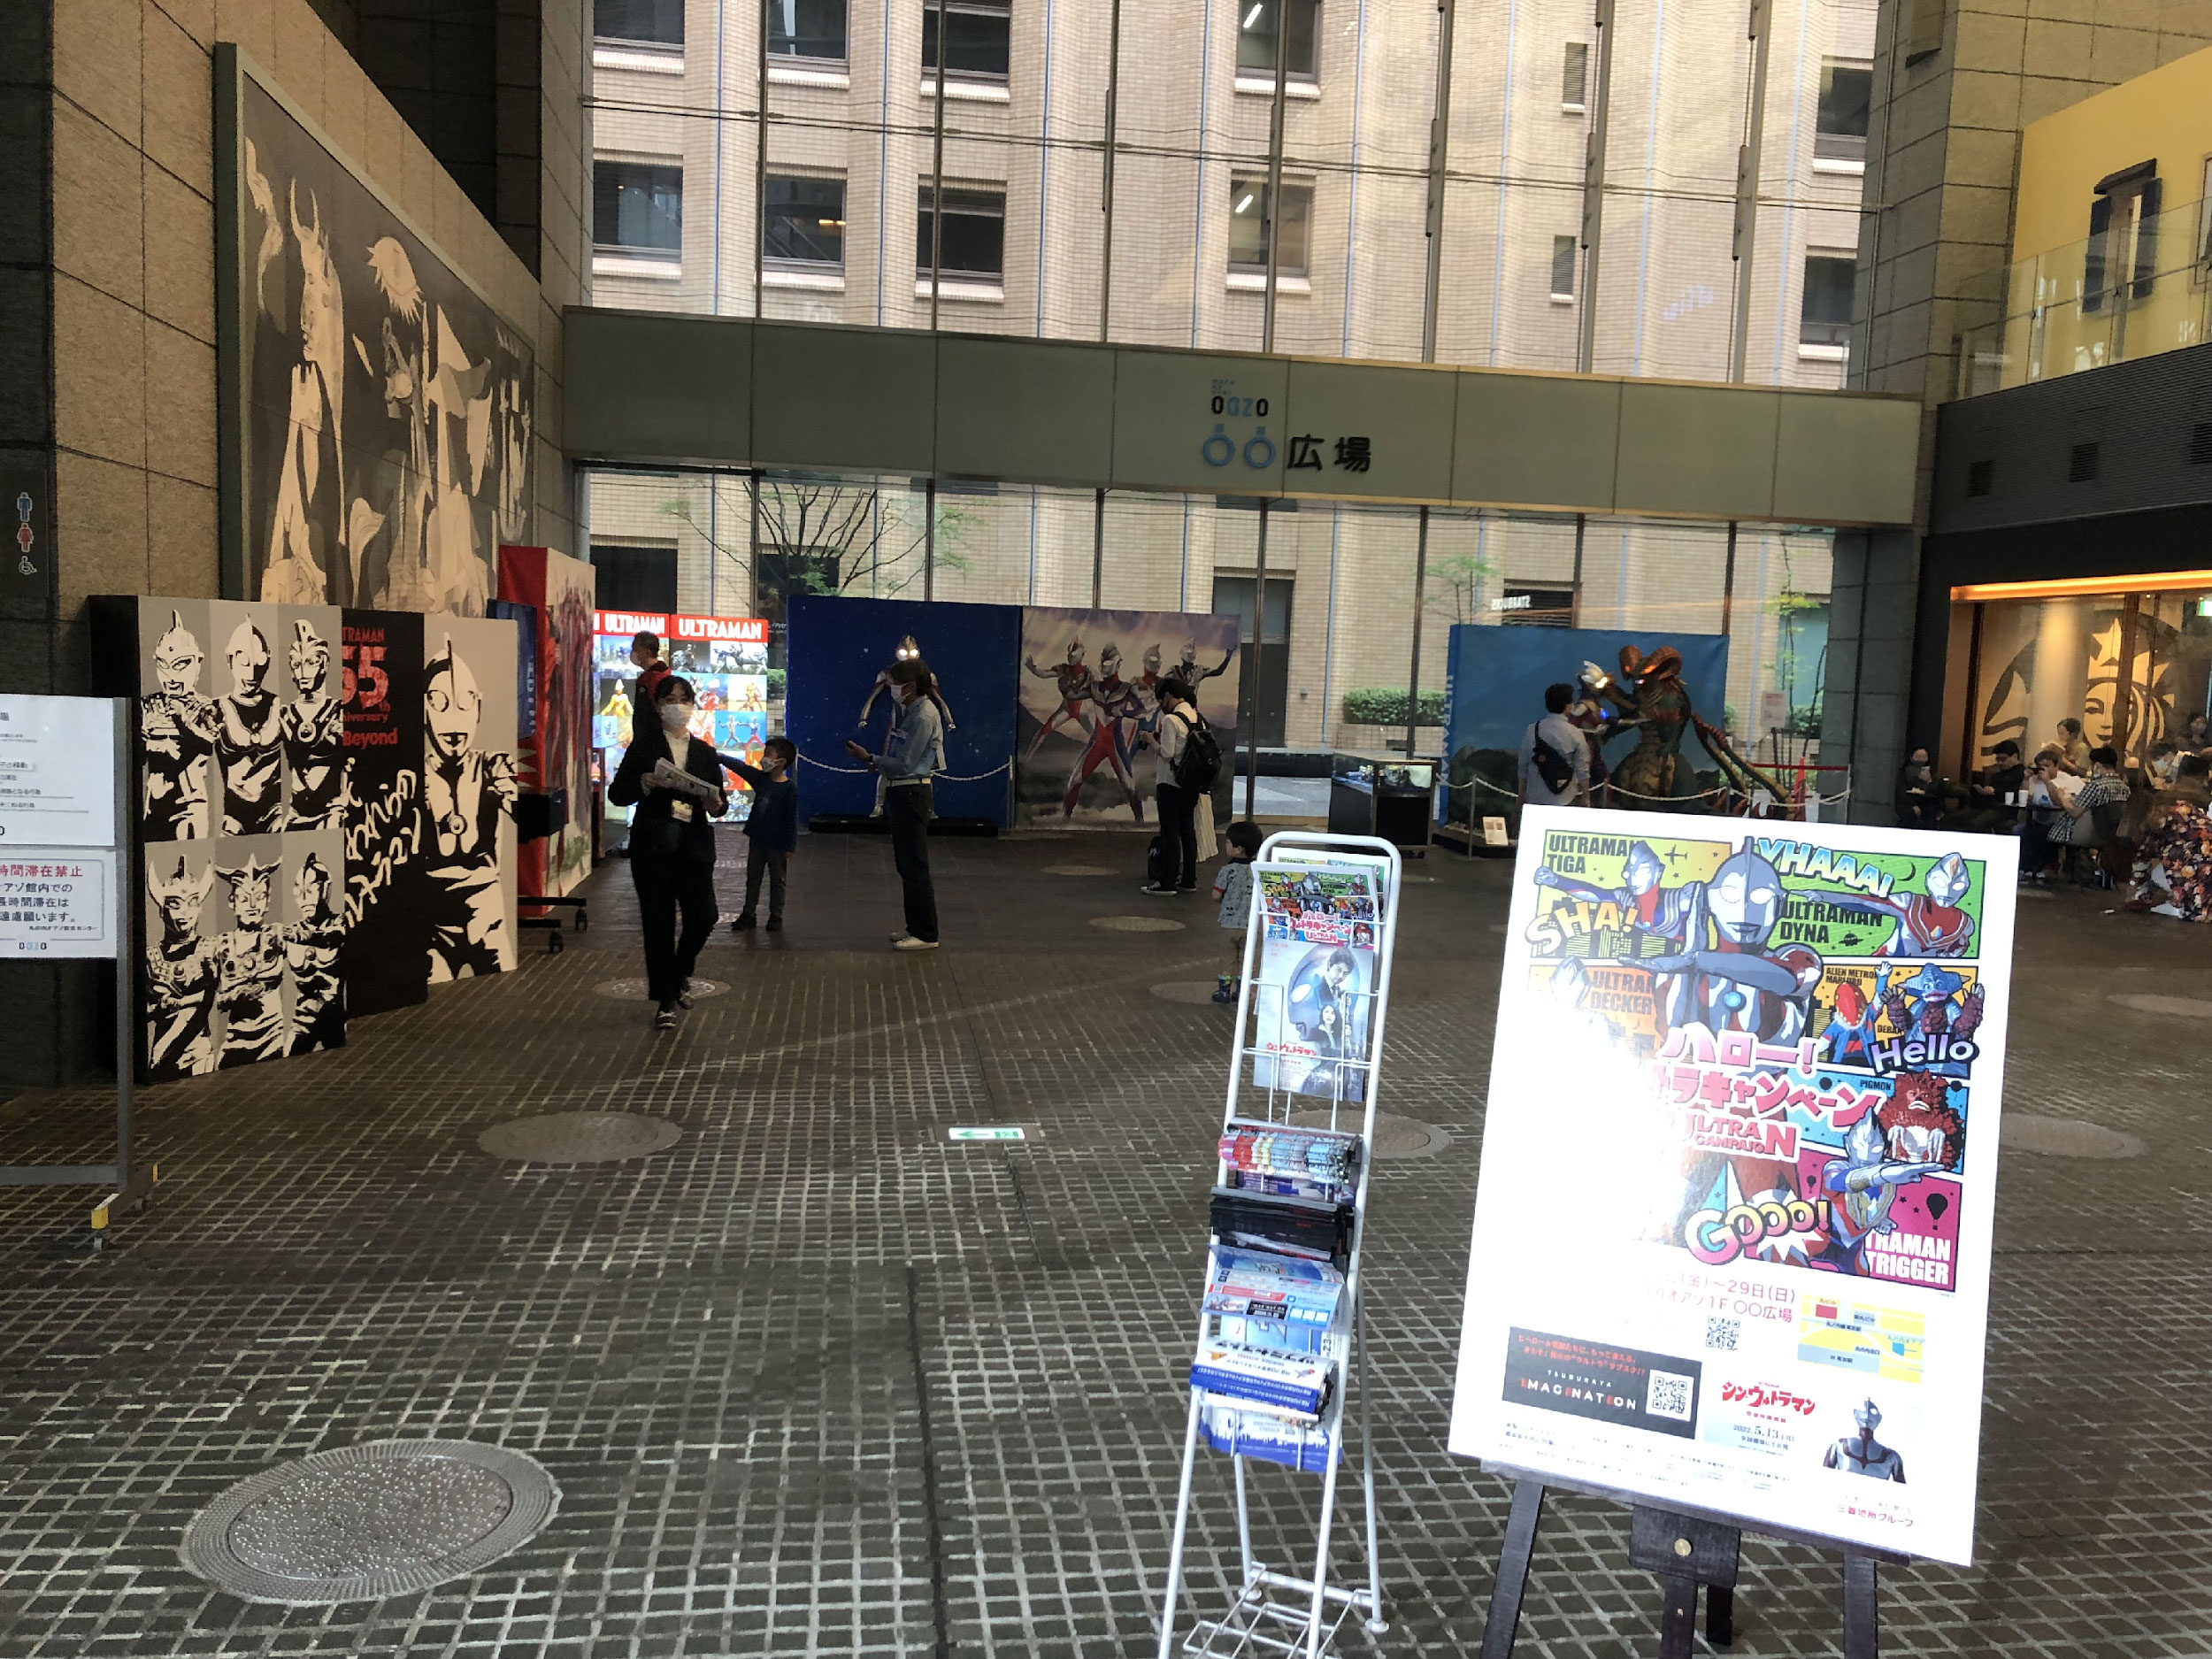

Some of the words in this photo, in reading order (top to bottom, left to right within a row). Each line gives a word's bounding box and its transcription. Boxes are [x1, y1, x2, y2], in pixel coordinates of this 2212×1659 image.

[1287, 434, 1371, 472] 広場
[342, 626, 385, 641] TRAMAN
[604, 612, 665, 634] ULTRAMAN
[678, 618, 762, 640] ULTRAMAN
[342, 727, 398, 749] Beyond
[345, 806, 422, 928] ルトラマン
[1548, 854, 1586, 874] TIGA
[1783, 900, 1883, 927] ULTRAMAN
[1525, 901, 1639, 955] SHA!
[1780, 921, 1829, 944] DYNA
[1826, 967, 1847, 977] ALIEN
[1590, 991, 1653, 1016] DECKER
[1662, 1033, 1815, 1074] ハロー!
[1870, 1033, 1974, 1074] Hello
[1652, 1064, 1881, 1126] トラキャンペーン
[1860, 1079, 1892, 1091] PIGMON
[1865, 1250, 1950, 1286] TRIGGER
[1520, 1378, 1638, 1410] IMAGINATION
